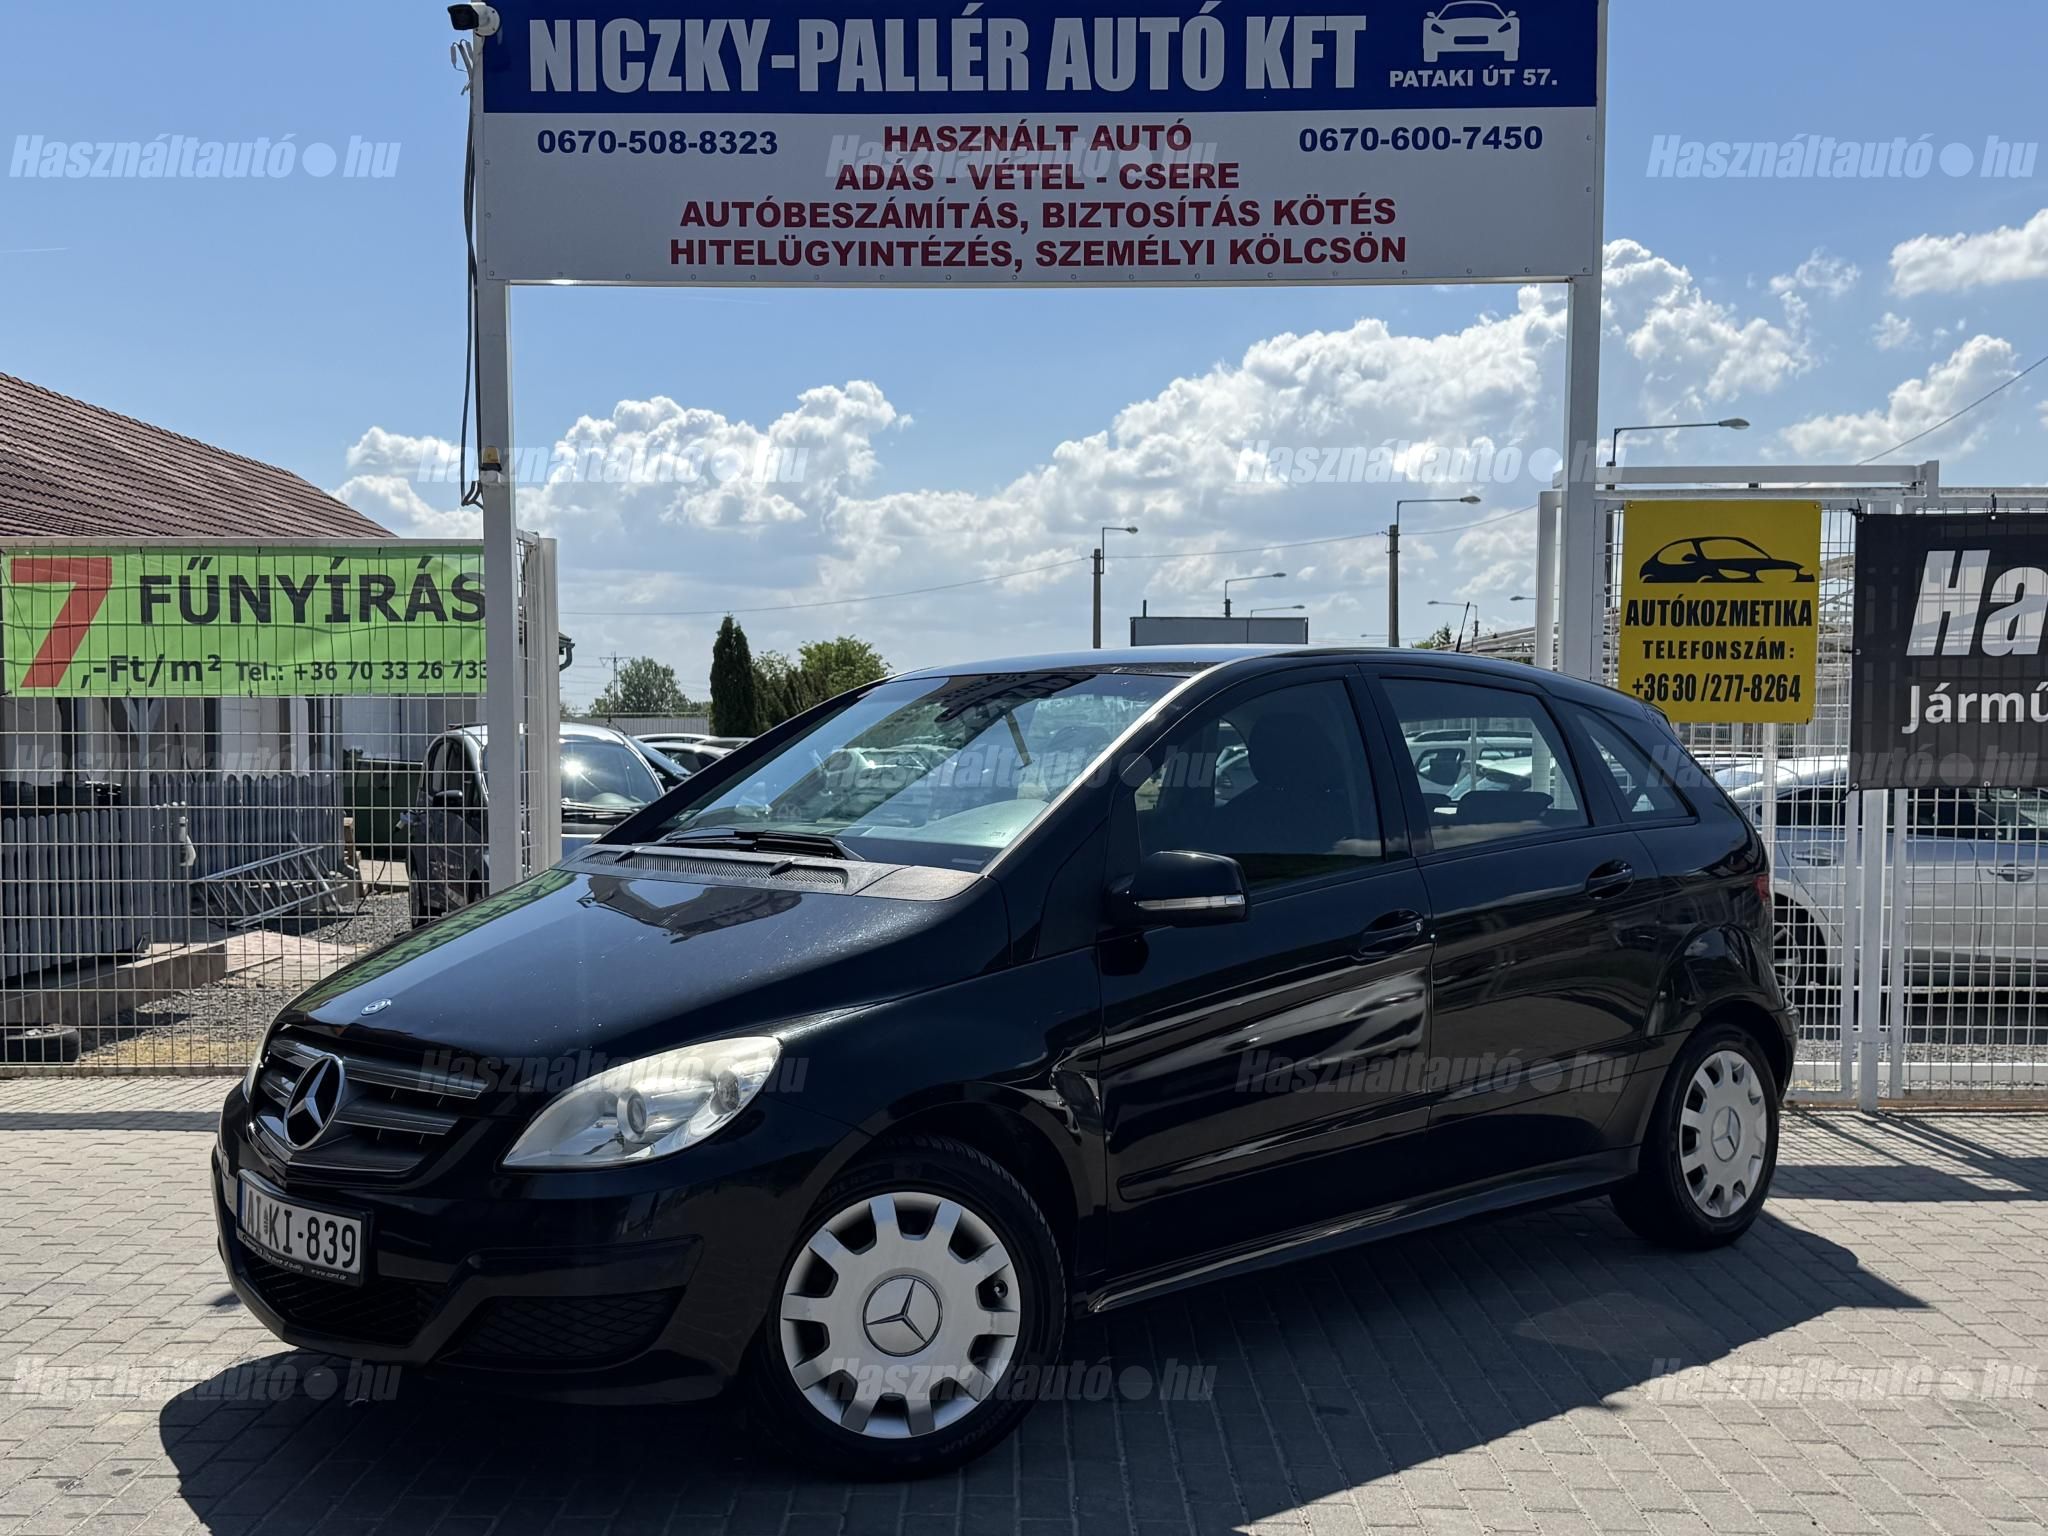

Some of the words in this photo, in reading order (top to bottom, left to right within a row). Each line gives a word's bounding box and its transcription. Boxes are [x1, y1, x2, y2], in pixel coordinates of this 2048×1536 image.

[529, 2, 1029, 94] NICZKY-PALLÉR
[1046, 0, 1226, 92] AUTÓ
[1245, 15, 1366, 91] KFT
[1389, 69, 1474, 89] PATAKI
[1482, 65, 1515, 87] ÚT
[1522, 68, 1558, 87] 57.
[537, 129, 778, 156] 0670-508-8323
[883, 119, 1079, 152] HASZNÁLT
[1090, 118, 1192, 152] AUTÓ
[1299, 126, 1543, 153] 0670-600-7450
[835, 158, 934, 191] ADÁS
[967, 158, 1085, 191] VÉTEL
[1119, 162, 1240, 190] CSERE
[680, 196, 1029, 235] AUTÓBESZÁMÍTÁS,
[1042, 195, 1260, 229] BIZTOSÍTÁS
[1273, 192, 1397, 227] KÖTÉS
[670, 234, 1023, 273] HITELÜGYINTÉZÉS,
[1035, 233, 1216, 267] SZEMÉLYI
[1229, 231, 1406, 265] KÖLCSÖN
[140, 556, 486, 625] FŰNYÍRÁS
[10, 557, 112, 688] 7
[1625, 594, 1812, 627] AUTÓKOZMETIKA
[1643, 636, 1795, 660] TELEFONSZÁM:
[294, 662, 338, 683] +36
[347, 661, 374, 681] 70
[381, 661, 408, 680] 33
[417, 660, 443, 680] 26
[268, 1203, 356, 1269] KI-839
